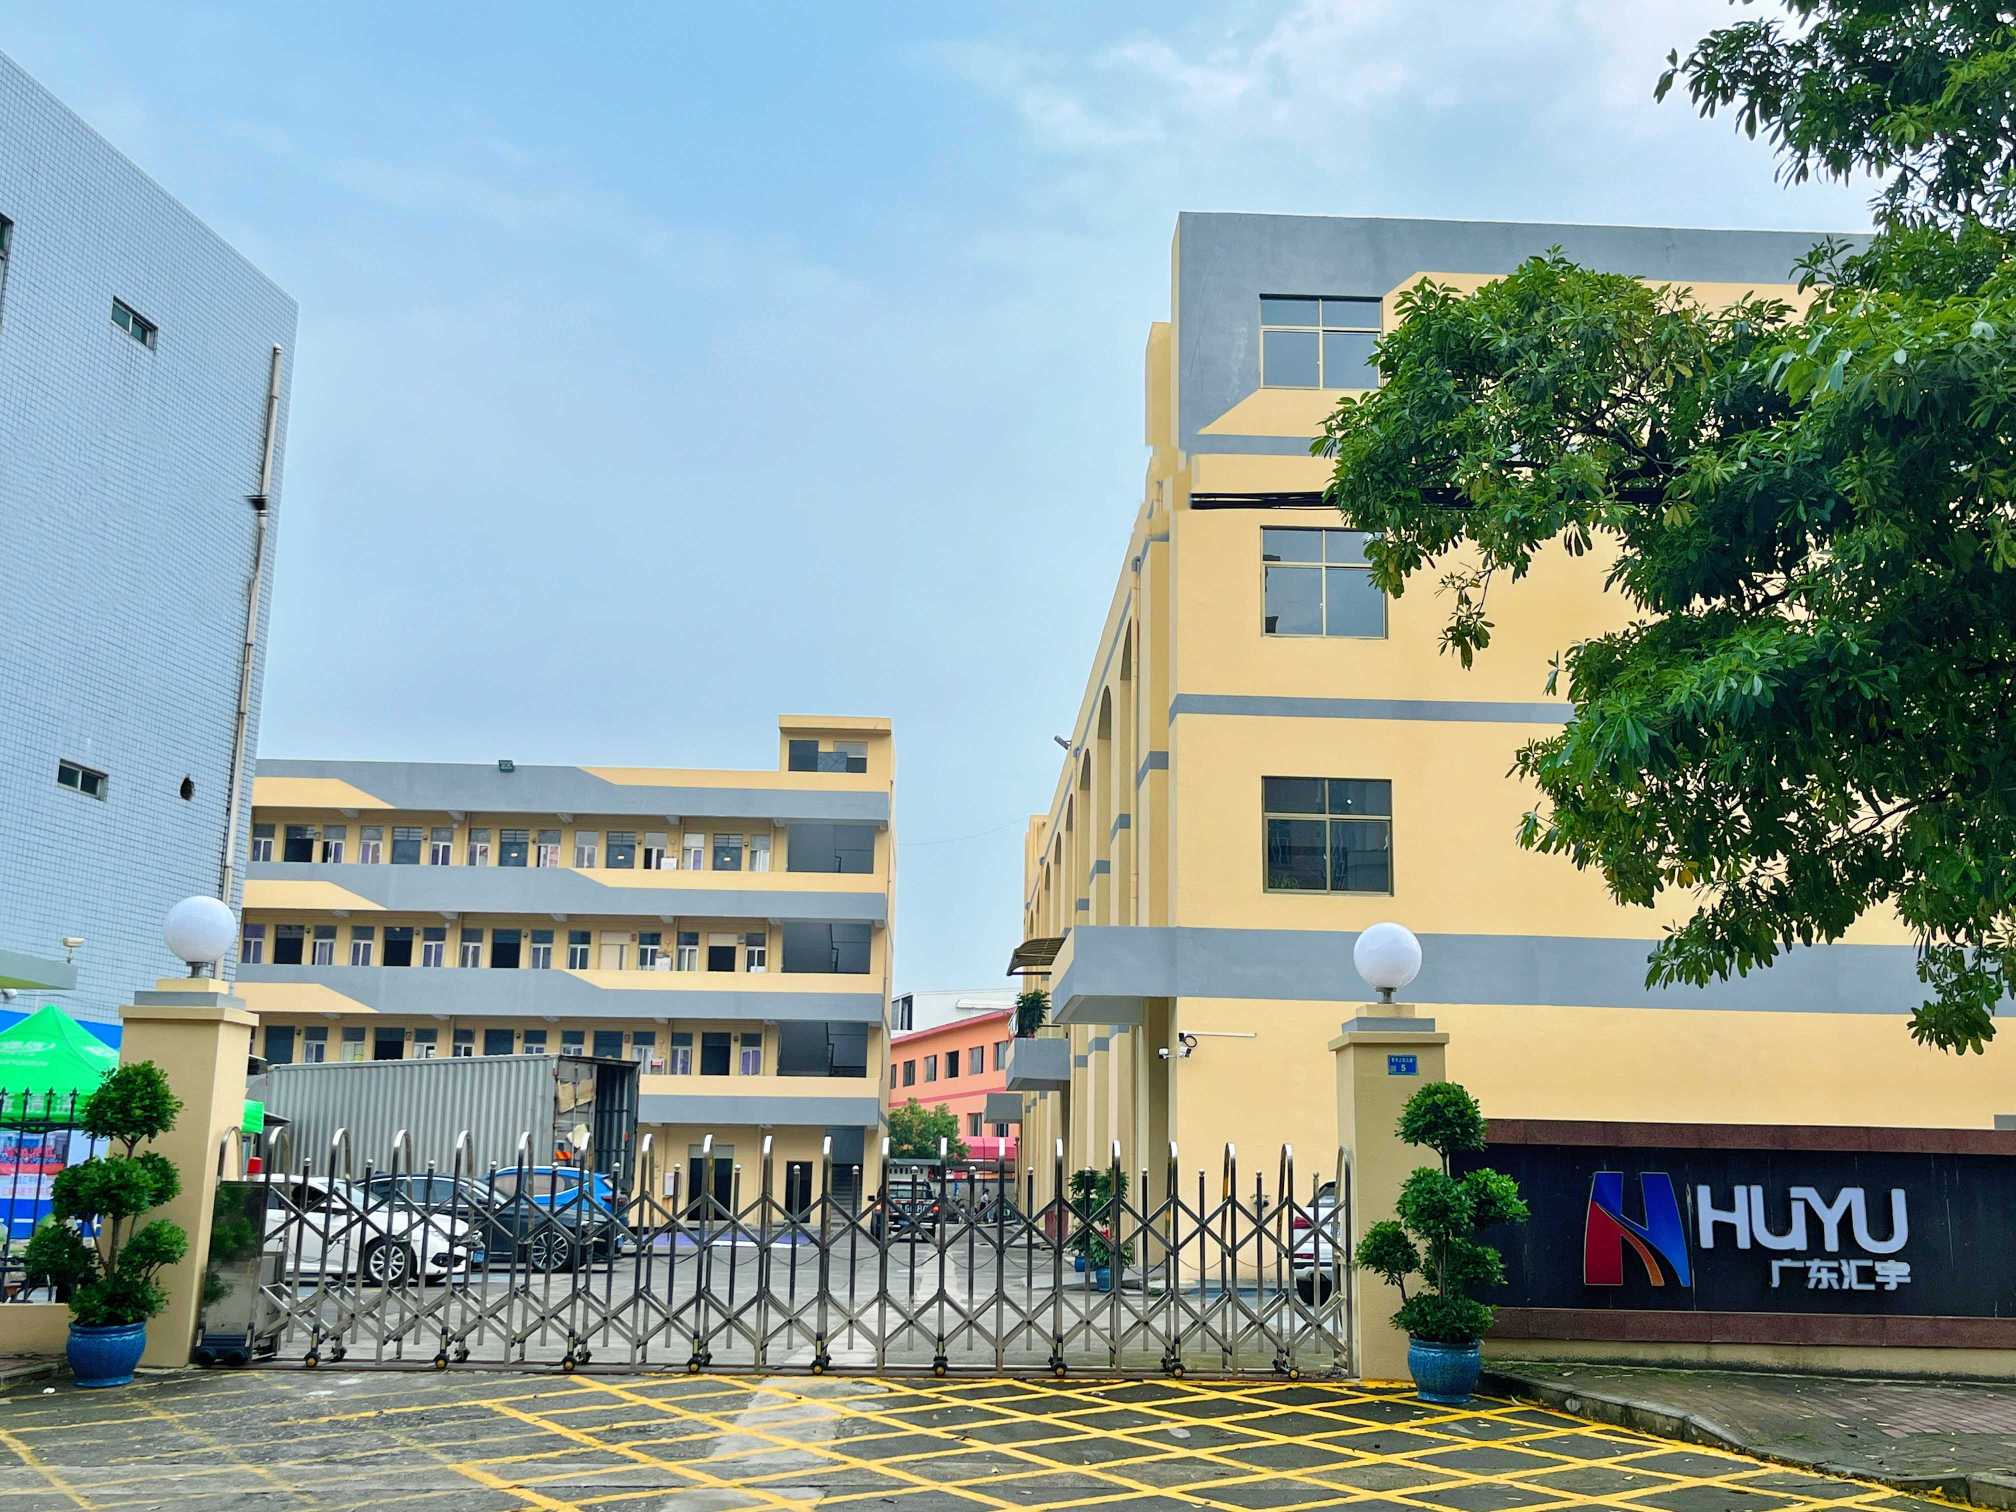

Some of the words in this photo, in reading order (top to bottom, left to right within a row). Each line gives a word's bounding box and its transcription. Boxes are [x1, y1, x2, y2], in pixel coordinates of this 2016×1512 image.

[1696, 1184, 1909, 1254] HUYU
[1771, 1258, 1911, 1290] 广东汇宇
